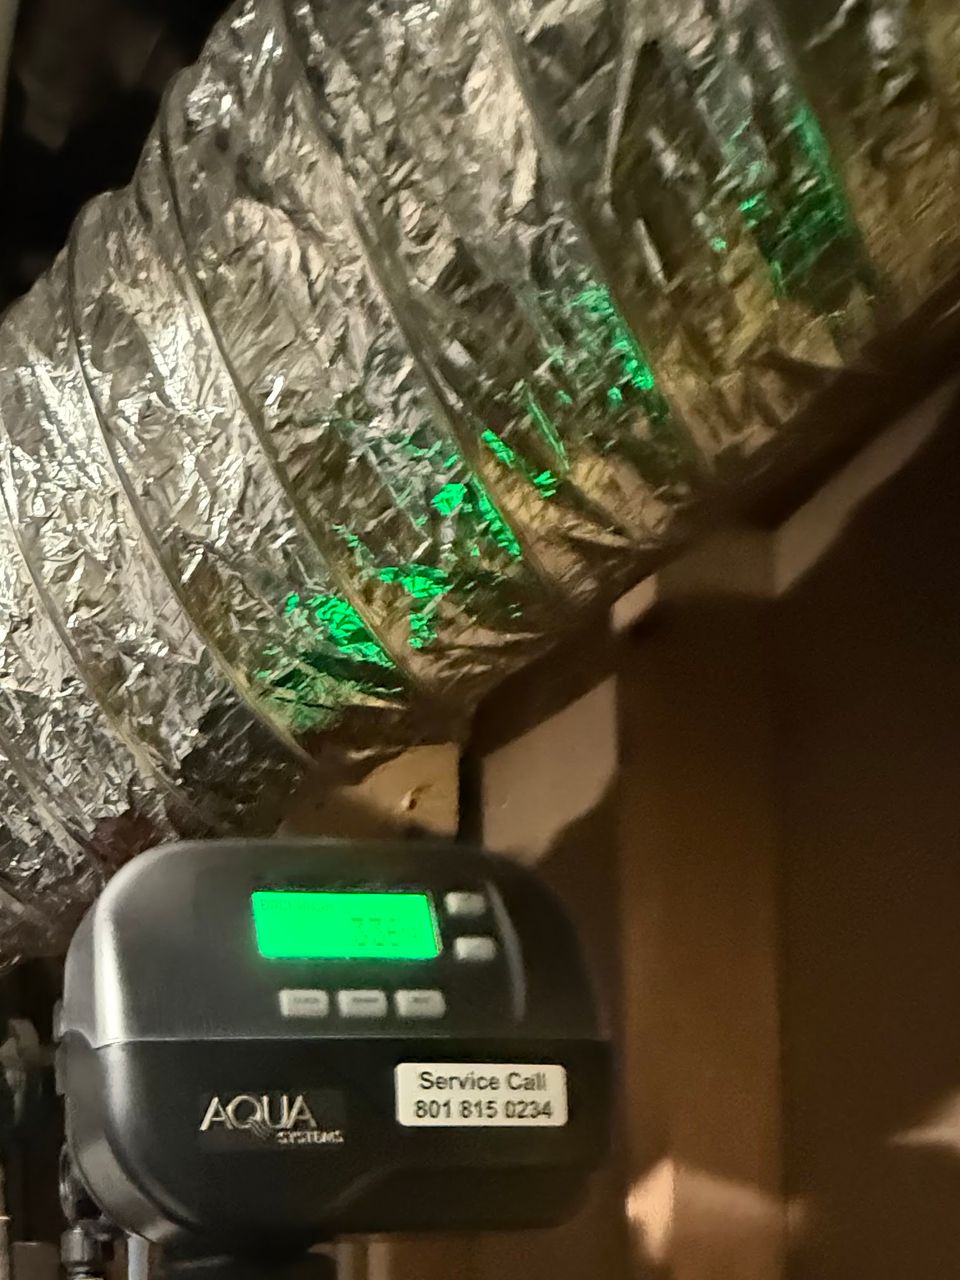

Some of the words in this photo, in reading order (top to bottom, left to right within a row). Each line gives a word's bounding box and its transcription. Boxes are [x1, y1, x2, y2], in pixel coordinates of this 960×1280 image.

[419, 1071, 500, 1090] Service
[507, 1071, 547, 1091] Call
[200, 1094, 318, 1139] AQUA
[415, 1100, 452, 1119] 801
[459, 1100, 498, 1119] 815
[504, 1100, 552, 1119] 0234
